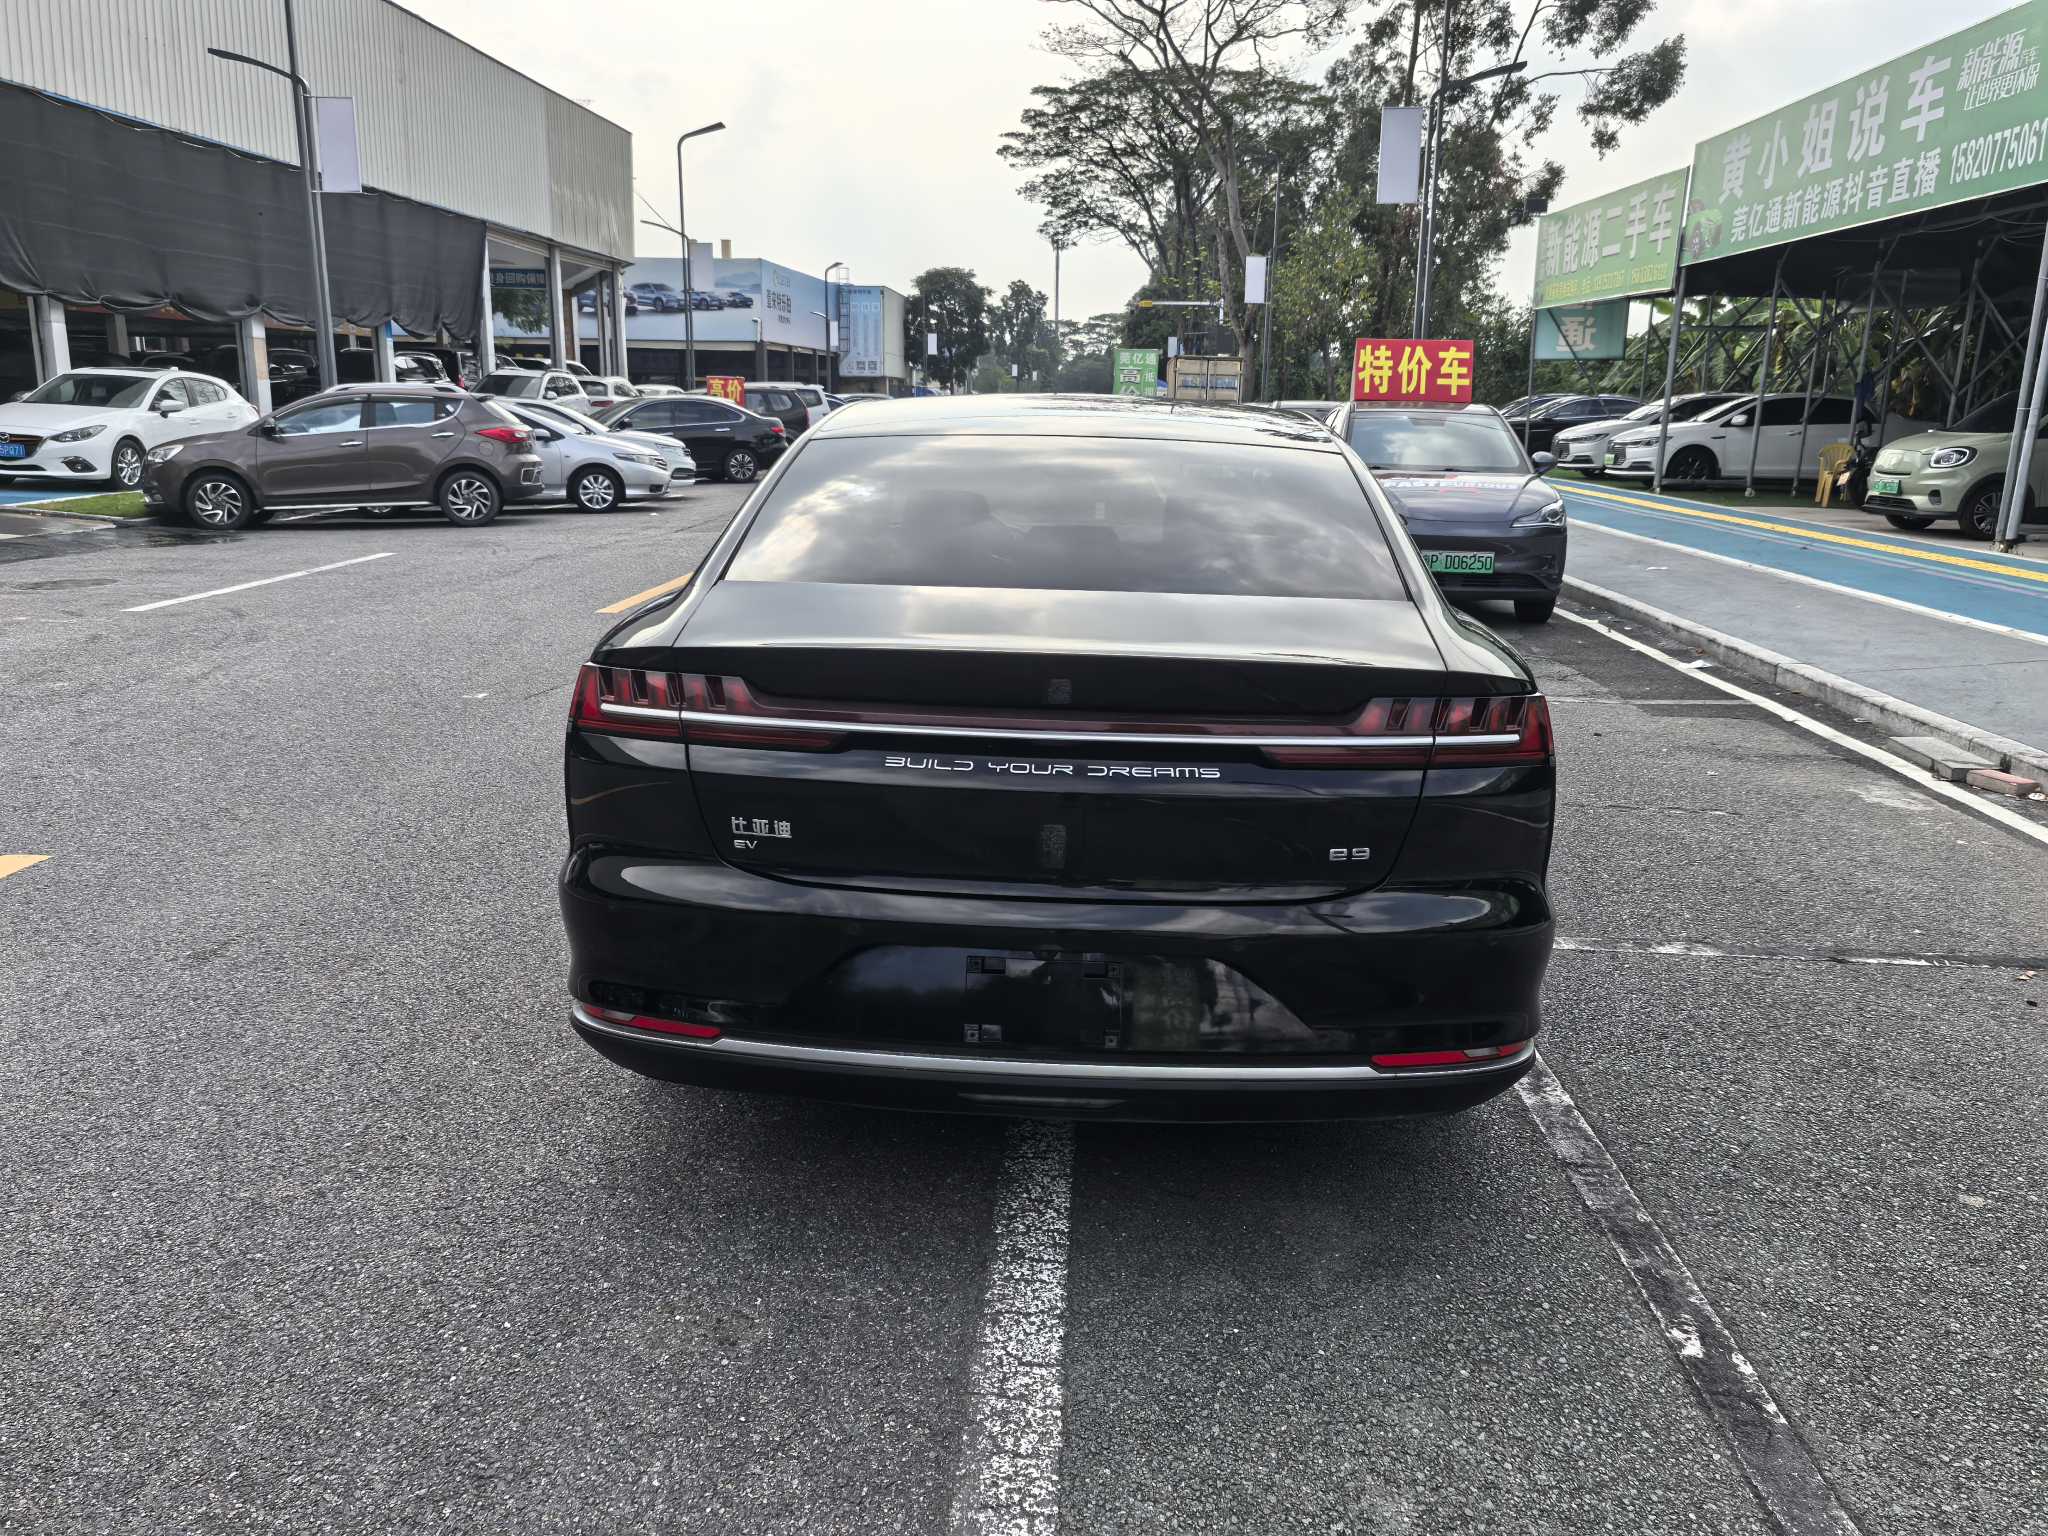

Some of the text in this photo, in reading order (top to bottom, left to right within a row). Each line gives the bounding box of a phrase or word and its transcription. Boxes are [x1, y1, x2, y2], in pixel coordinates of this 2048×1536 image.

[1963, 62, 2041, 111] 让世界更环保
[1718, 55, 1952, 204] 黄小姐说车
[1950, 117, 2048, 185] 15820775061
[1730, 146, 1942, 244] 莞亿通新能源抖音直播
[1545, 185, 1677, 277] 新能源二手车
[709, 378, 742, 402] 高价
[1357, 345, 1471, 396] 特价车
[885, 756, 1221, 778] BUILD YOUR DREAMS
[731, 816, 792, 838] 比亚迪
[734, 840, 758, 849] EV
